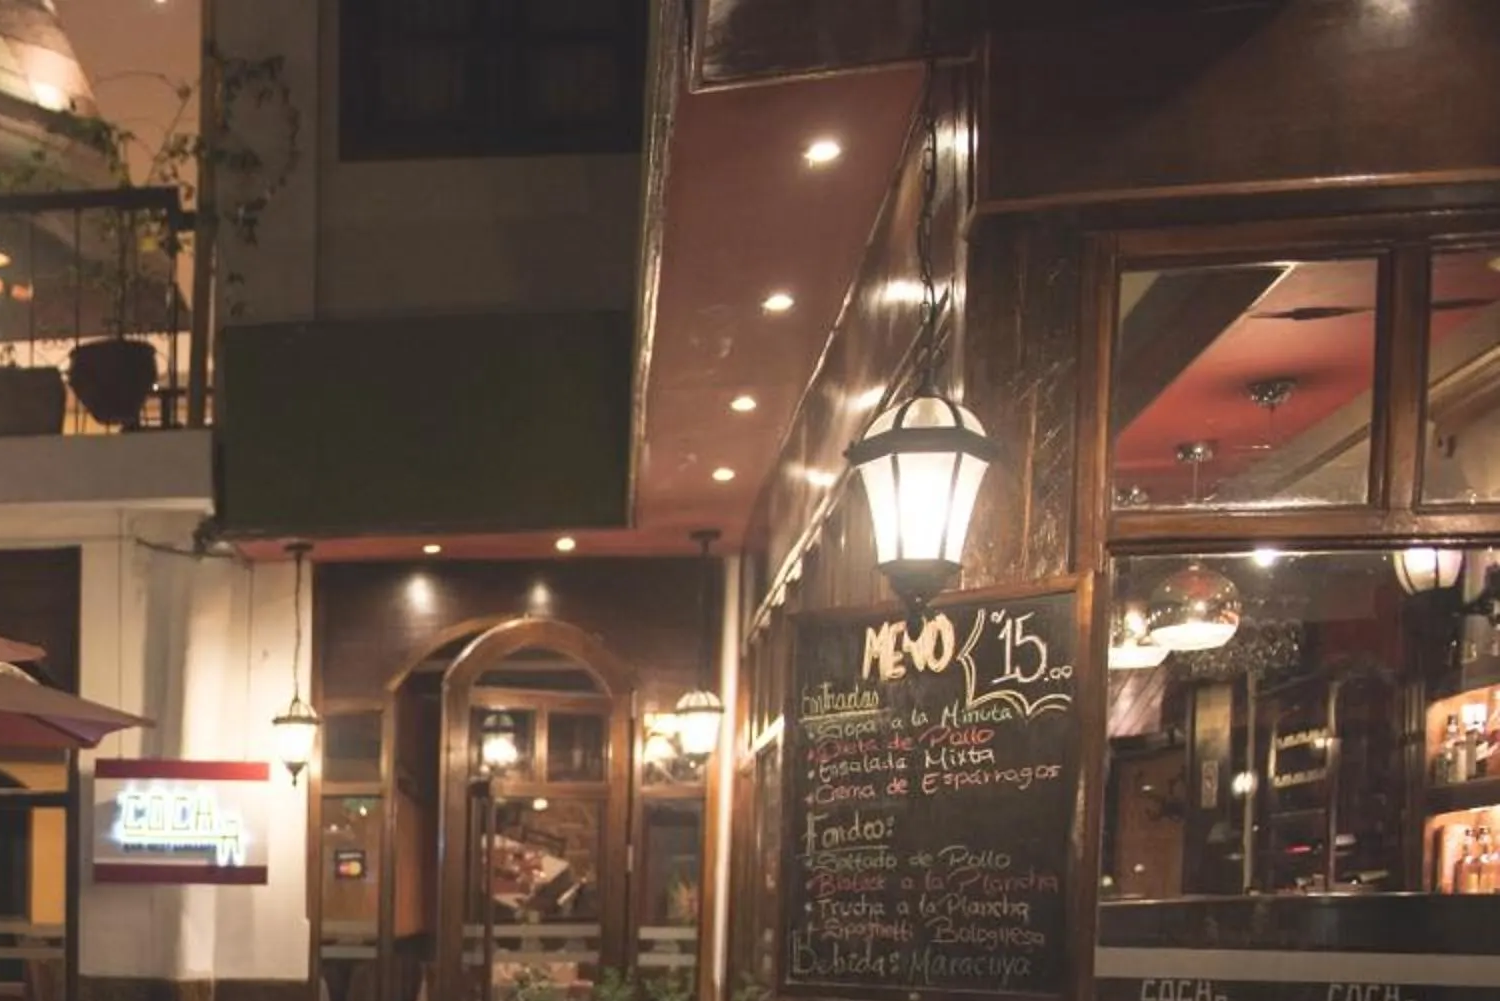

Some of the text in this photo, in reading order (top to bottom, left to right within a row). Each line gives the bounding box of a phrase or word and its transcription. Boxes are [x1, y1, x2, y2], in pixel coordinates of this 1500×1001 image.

[816, 699, 1013, 741] Sopa a la Minuta
[887, 732, 915, 751] de
[918, 725, 995, 748] Pollo
[924, 747, 995, 770] Mixta
[886, 777, 909, 796] de
[908, 849, 934, 868] de
[937, 844, 1011, 869] Pollo
[900, 876, 914, 890] a
[925, 868, 945, 891] la
[815, 893, 886, 920] Trucha
[896, 900, 910, 915] a
[918, 893, 937, 918] la
